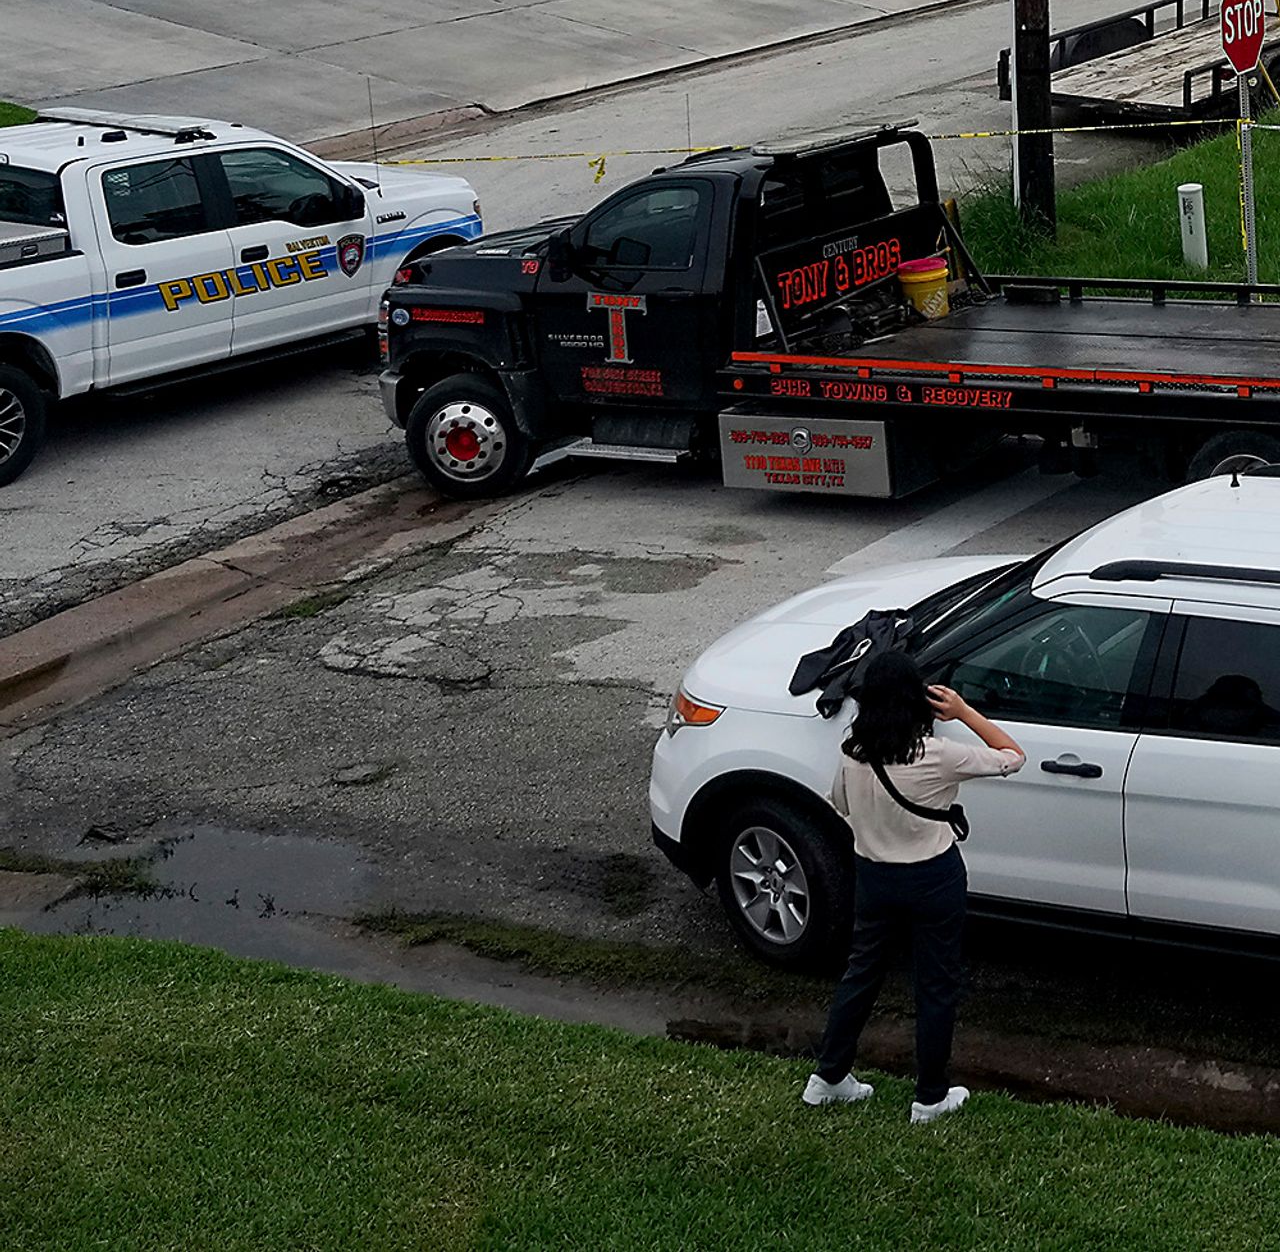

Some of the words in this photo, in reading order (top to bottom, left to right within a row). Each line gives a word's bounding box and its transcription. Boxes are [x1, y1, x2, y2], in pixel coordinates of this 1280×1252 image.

[823, 236, 858, 258] CENTURY
[158, 251, 328, 311] POLICE
[777, 260, 828, 309] TONY
[835, 255, 849, 291] &
[853, 238, 900, 285] BROS
[592, 295, 641, 307] TONY
[771, 378, 811, 397] 24HR
[820, 381, 888, 402] TOWING
[897, 386, 912, 402] &
[921, 387, 1013, 408] RECOVERY
[767, 456, 800, 471] TEXAS
[764, 472, 801, 484] TEXAS
